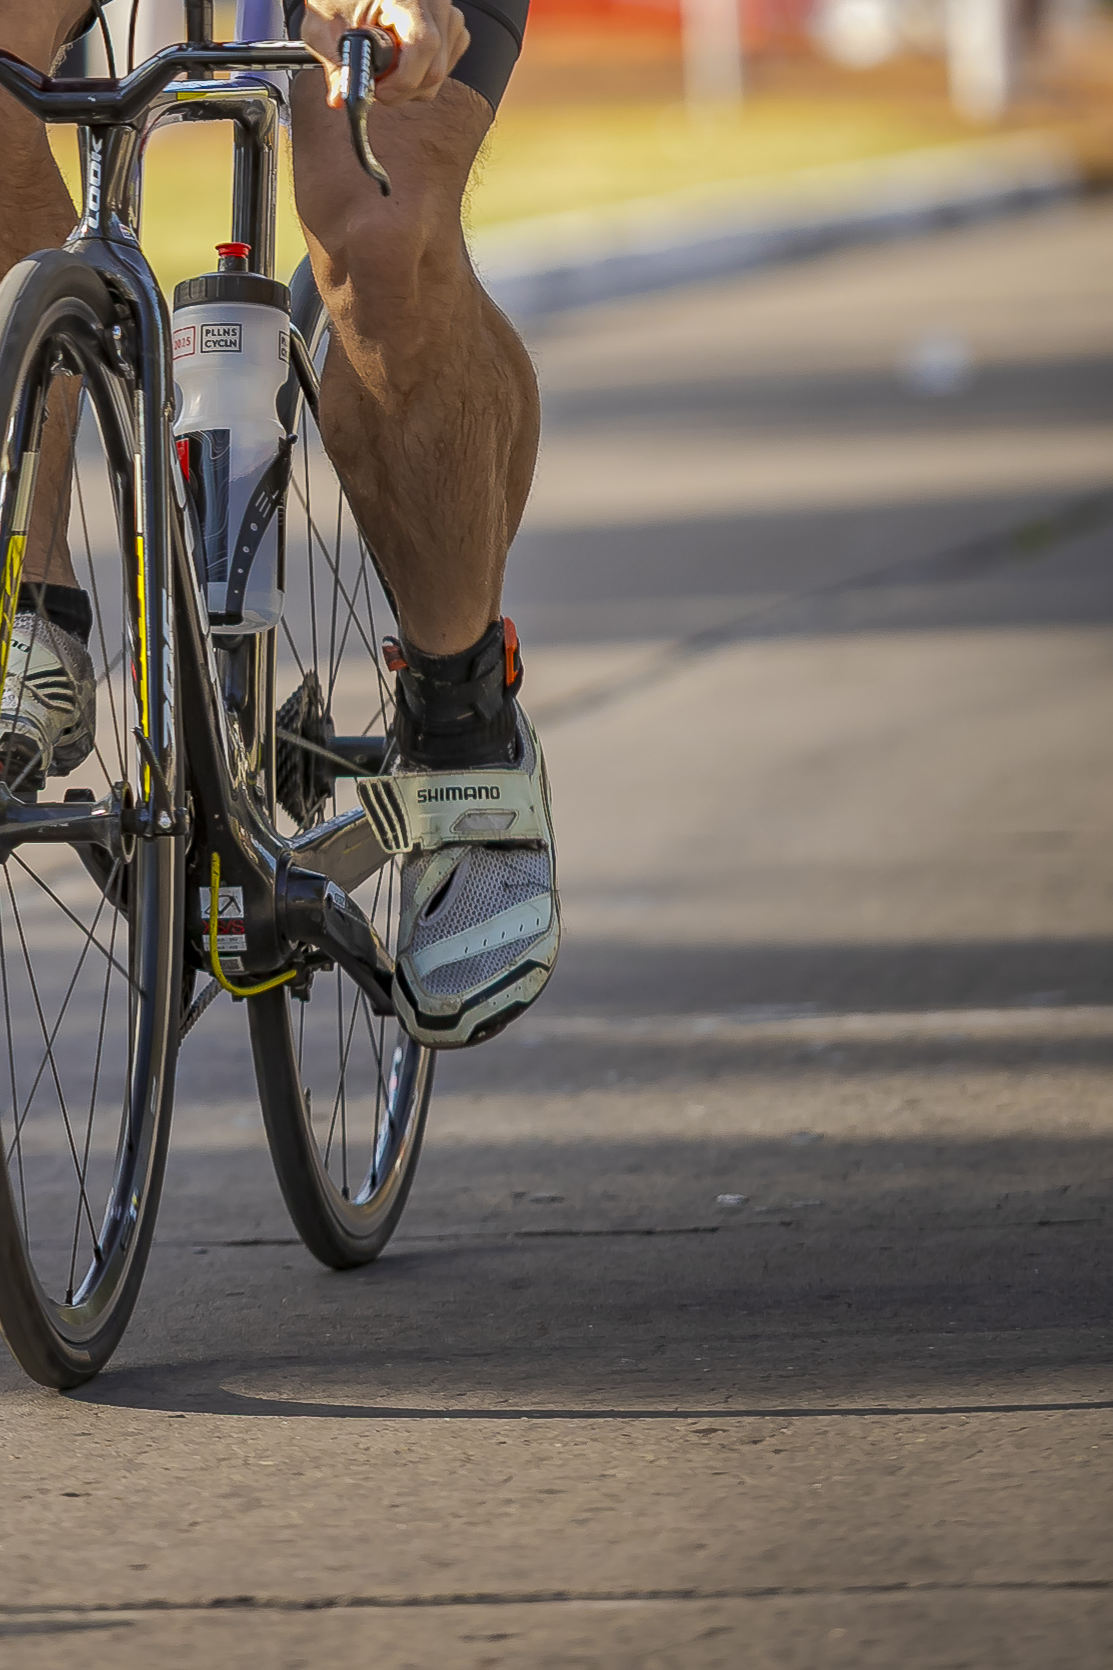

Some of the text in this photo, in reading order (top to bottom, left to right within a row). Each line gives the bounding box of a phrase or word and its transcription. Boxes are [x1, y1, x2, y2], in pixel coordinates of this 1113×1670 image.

[88, 134, 103, 229] LOOK
[205, 328, 237, 337] PLLNS
[204, 339, 237, 348] CYCLN
[417, 785, 501, 804] SHIMANO
